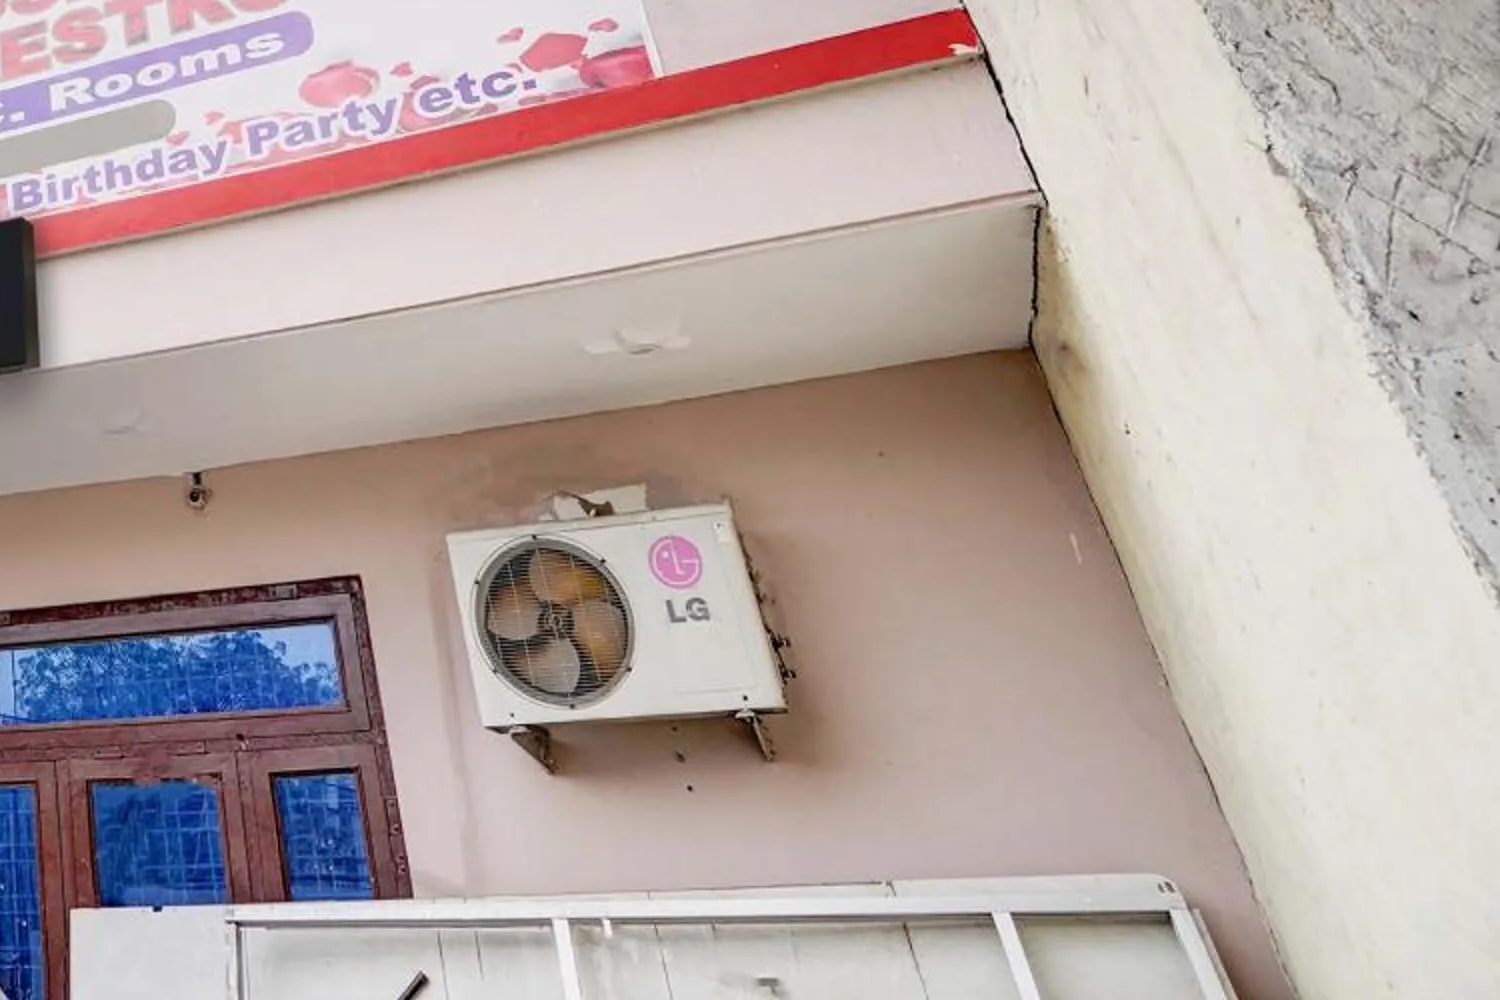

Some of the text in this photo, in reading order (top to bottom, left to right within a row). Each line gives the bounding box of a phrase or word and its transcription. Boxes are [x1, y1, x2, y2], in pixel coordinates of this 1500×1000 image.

[48, 33, 285, 114] Rooms
[12, 138, 228, 212] Birthday
[247, 97, 398, 156] Party
[419, 69, 538, 113] etc.
[665, 597, 711, 624] LG
